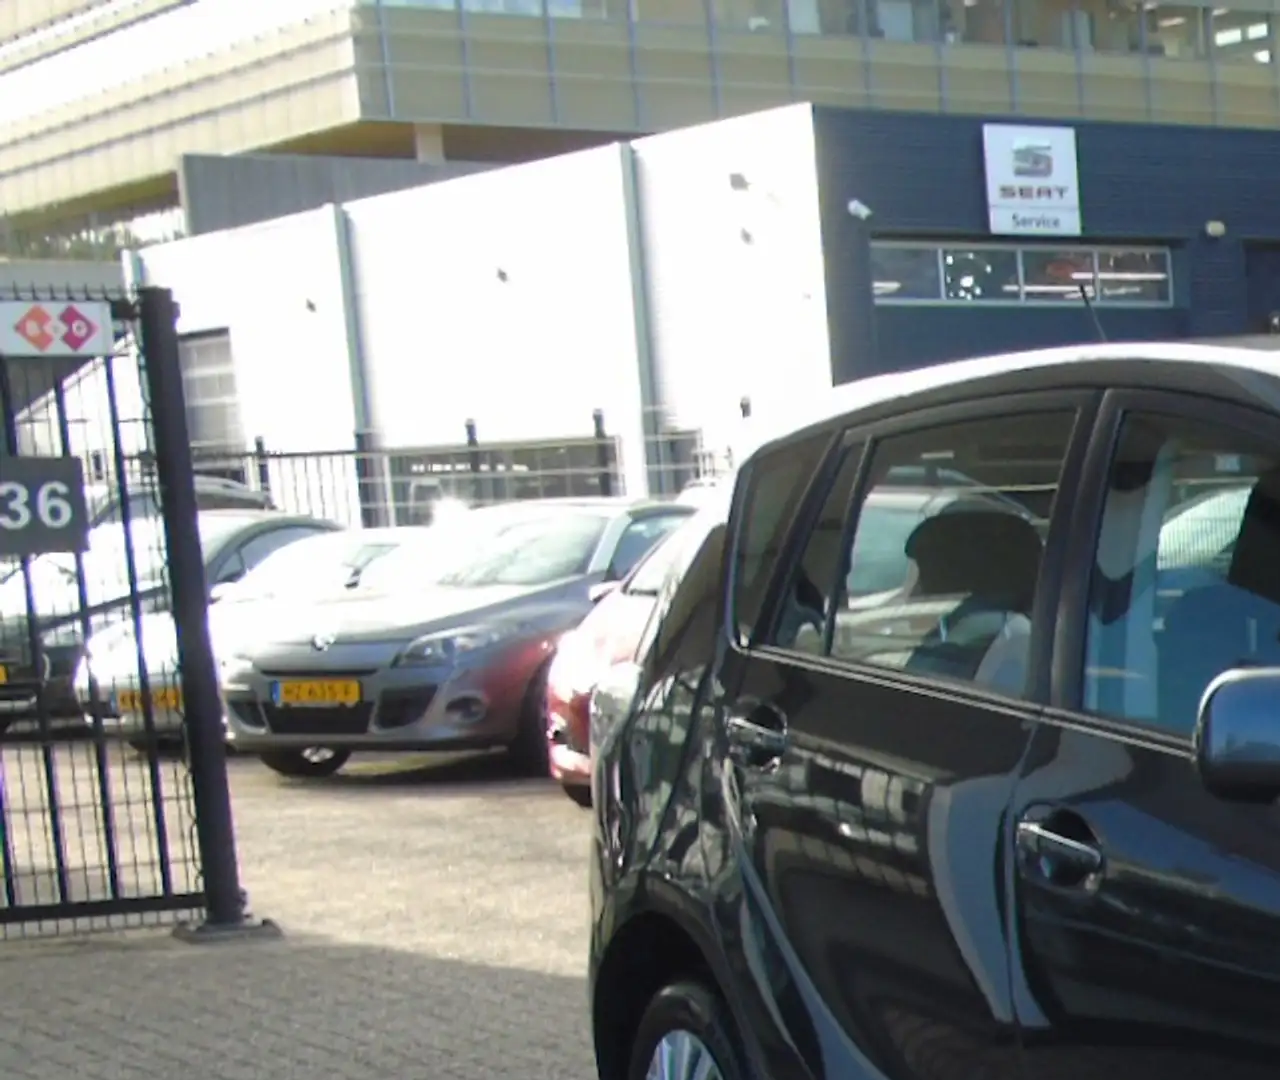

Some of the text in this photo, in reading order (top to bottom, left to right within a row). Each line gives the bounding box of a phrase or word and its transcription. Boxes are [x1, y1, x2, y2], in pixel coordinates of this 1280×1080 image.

[999, 185, 1069, 199] SEAT
[1011, 213, 1060, 228] Service
[0, 481, 73, 530] 36
